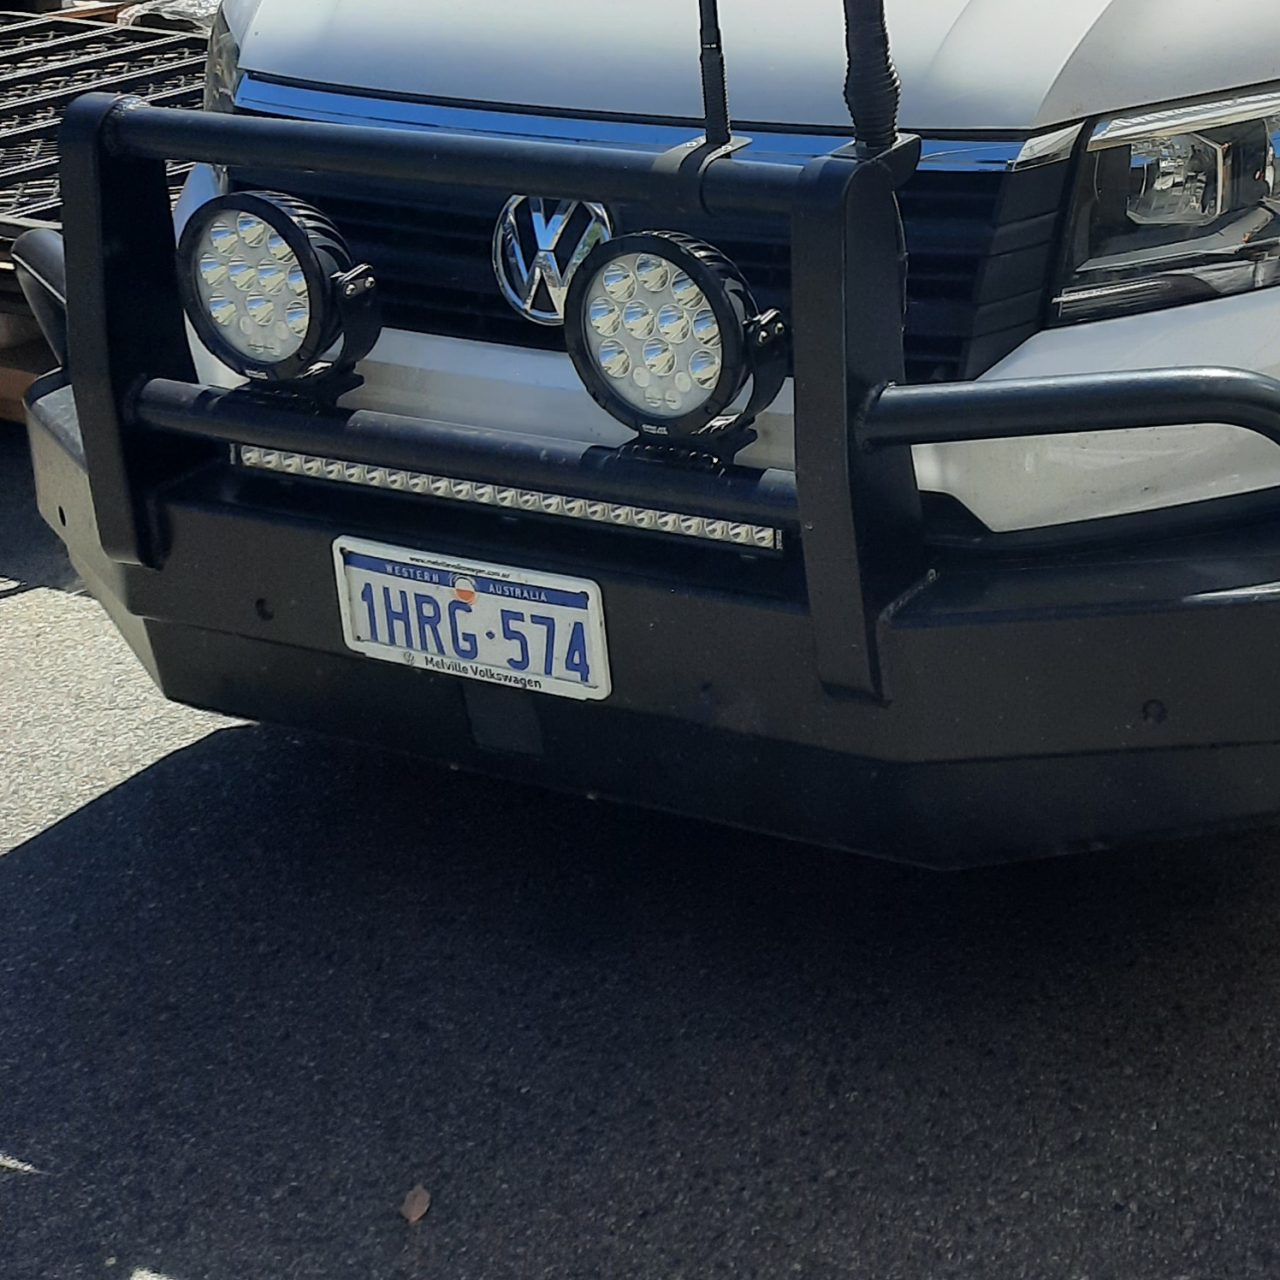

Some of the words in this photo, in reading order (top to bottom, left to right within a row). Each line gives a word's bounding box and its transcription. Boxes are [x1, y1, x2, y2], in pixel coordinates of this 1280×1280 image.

[384, 563, 440, 584] WESTERN
[488, 582, 548, 602] AUSTRALIA
[424, 655, 469, 675] Melville
[470, 664, 543, 689] Volkswagen
